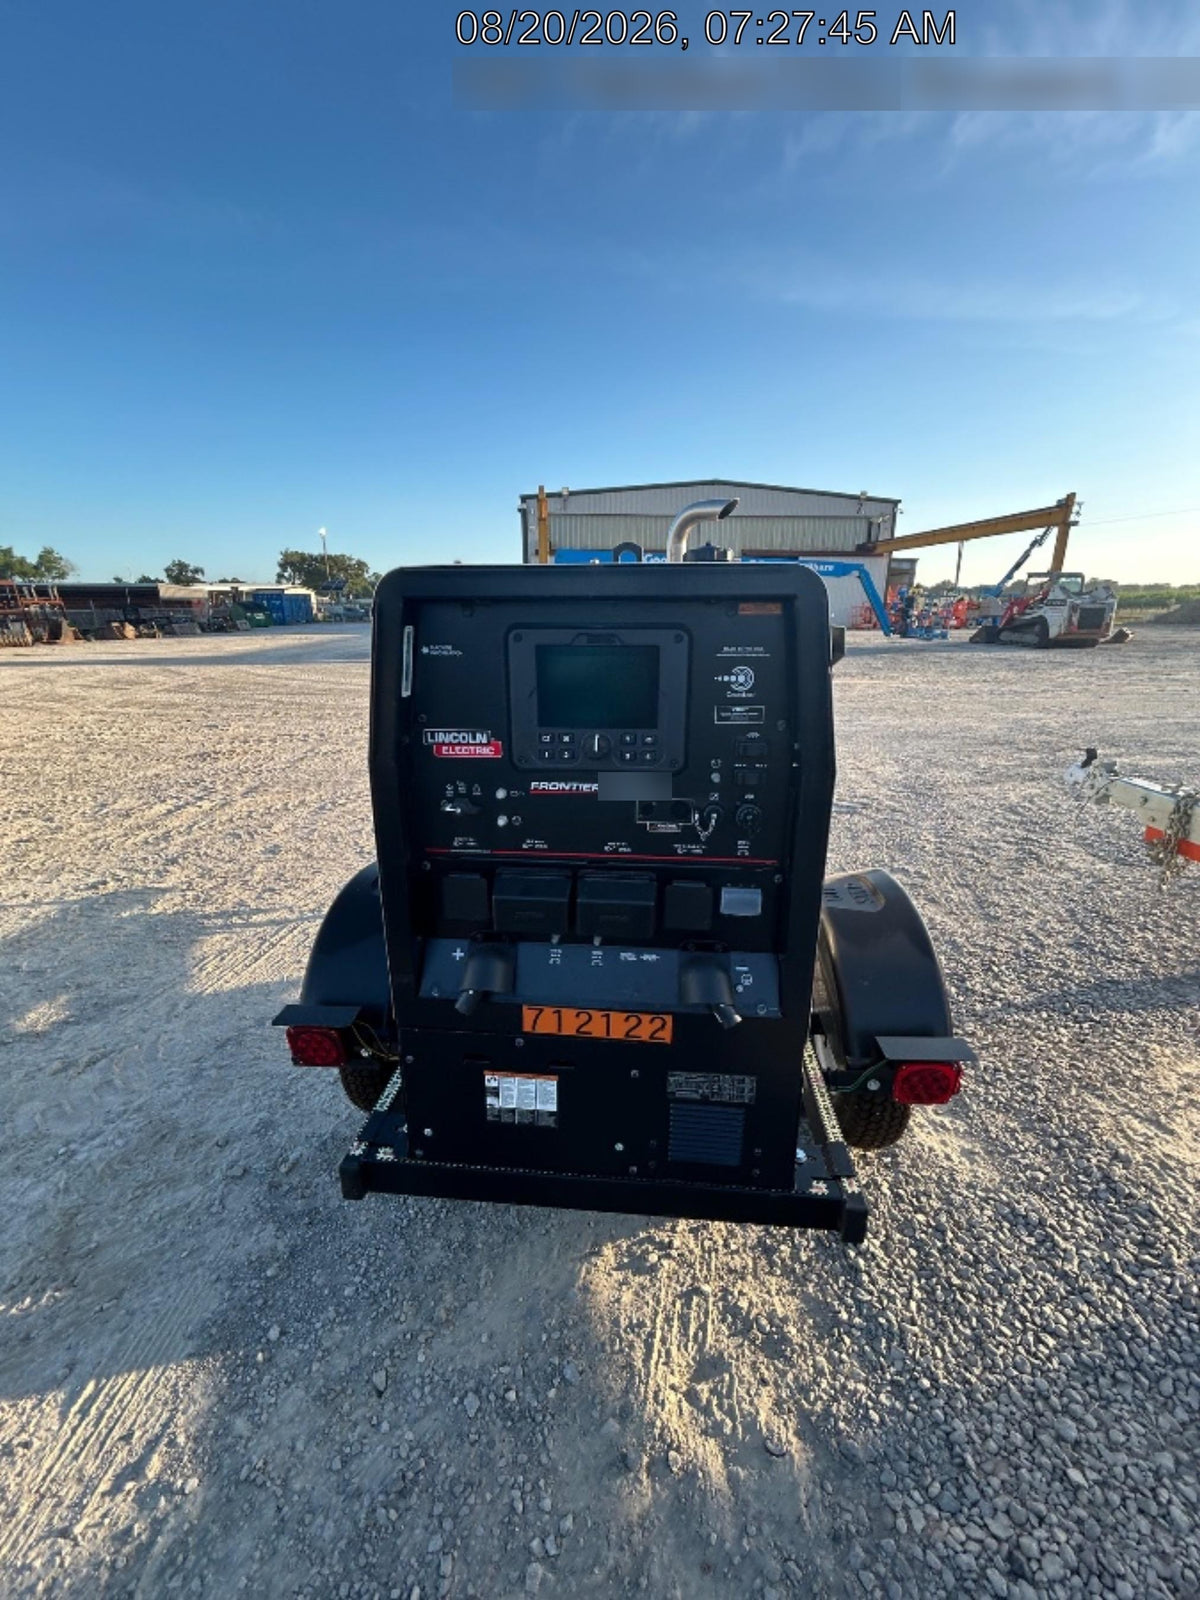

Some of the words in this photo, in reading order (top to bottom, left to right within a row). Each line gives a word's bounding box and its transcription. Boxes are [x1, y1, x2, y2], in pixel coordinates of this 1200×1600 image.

[427, 731, 488, 744] LINCOLN
[441, 745, 496, 755] ELECTRIC
[526, 1007, 668, 1041] 712122
